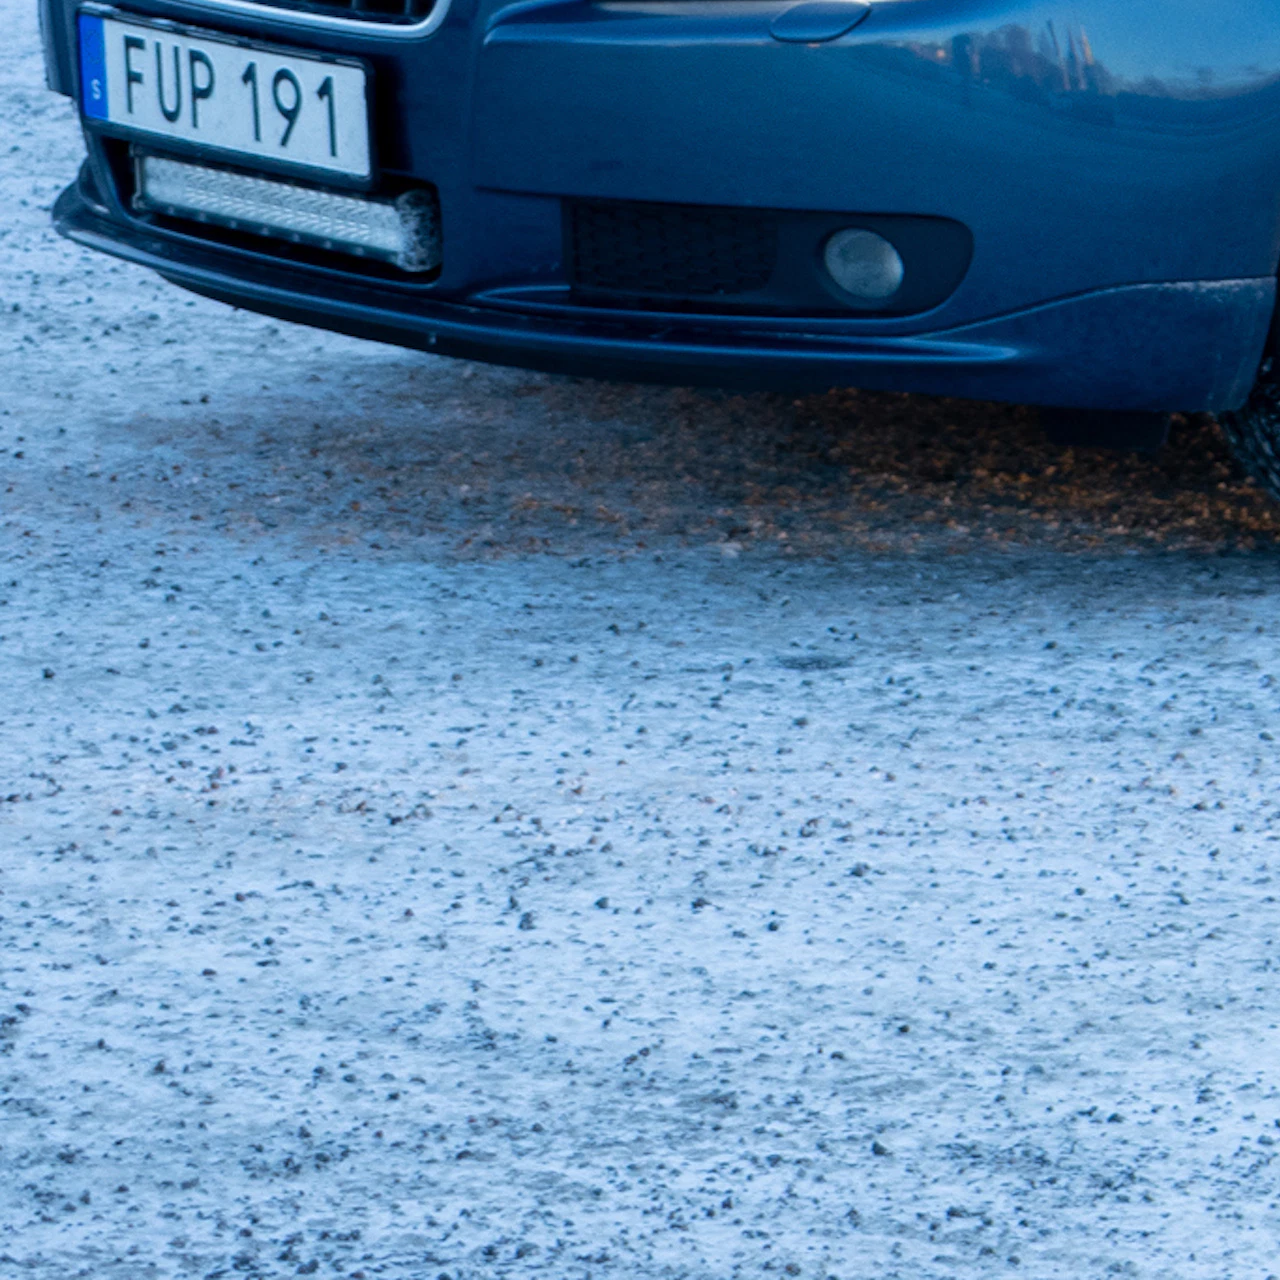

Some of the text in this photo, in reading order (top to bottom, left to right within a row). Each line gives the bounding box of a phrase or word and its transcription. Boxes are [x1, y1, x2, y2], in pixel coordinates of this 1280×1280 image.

[91, 78, 101, 100] S
[123, 34, 338, 158] FUP 191
